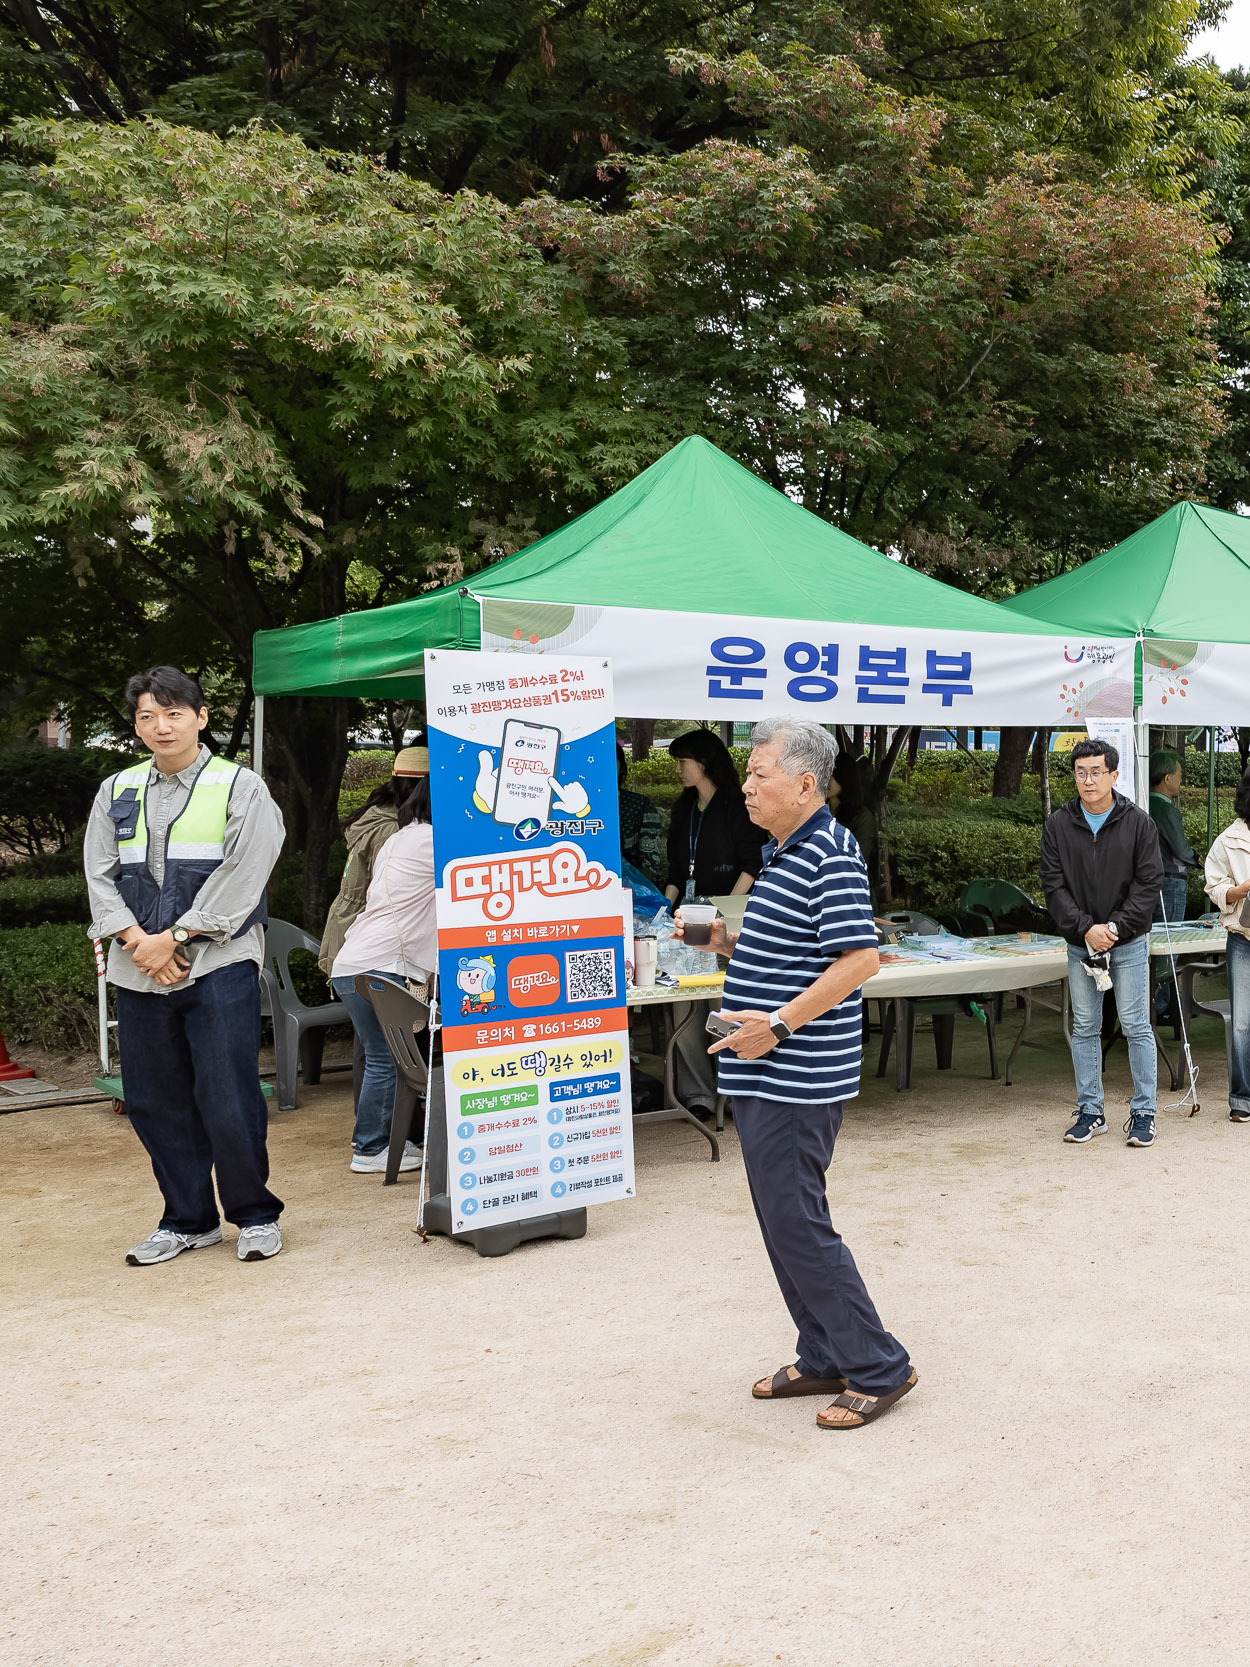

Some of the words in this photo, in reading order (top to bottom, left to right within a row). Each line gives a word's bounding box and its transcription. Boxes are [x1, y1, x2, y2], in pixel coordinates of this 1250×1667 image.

[452, 682, 473, 695] 모든
[476, 679, 505, 693] 가맹점
[508, 673, 558, 690] 중개수수료
[560, 668, 584, 683] 2%!
[705, 636, 974, 707] 운영본부
[437, 703, 468, 717] 이용자
[507, 757, 551, 776] 땡겨요
[546, 819, 604, 836] 광진구
[451, 848, 612, 921] 땡겨요
[485, 930, 496, 943] 앱
[501, 928, 523, 941] 설치
[527, 925, 570, 940] 바로가기
[511, 971, 559, 994] 땡겨요
[475, 1026, 515, 1045] 문의처
[538, 1017, 602, 1035] 1661-5489
[462, 1067, 484, 1082] 야,
[581, 1049, 613, 1069] 있어!
[553, 1083, 582, 1097] 고객님!
[584, 1080, 617, 1094] 땡겨요~
[465, 1096, 498, 1111] 사장님!
[500, 1091, 536, 1106] 땡겨요~
[565, 1105, 579, 1115] 상시
[606, 1099, 620, 1109] 할인
[462, 1126, 468, 1136] 1
[477, 1119, 520, 1134] 중개수수료
[522, 1116, 538, 1126] 2%
[553, 1136, 559, 1145] 2
[566, 1131, 591, 1143] 신규가입
[592, 1128, 608, 1138] 5천원
[609, 1125, 621, 1135] 할인
[463, 1151, 471, 1161] 2
[488, 1143, 523, 1156] 당일정산
[553, 1161, 561, 1170] 3
[567, 1158, 575, 1168] 첫
[576, 1156, 590, 1165] 주문
[591, 1152, 608, 1163] 5천원
[609, 1149, 622, 1159] 할인
[464, 1176, 472, 1186] 3
[479, 1171, 514, 1185] 나눔지원금
[515, 1166, 539, 1178] 30만원
[555, 1185, 562, 1194] 4
[569, 1179, 593, 1192] 리뷰작성
[593, 1176, 611, 1187] 포인트
[612, 1174, 624, 1183] 제공
[465, 1202, 474, 1212] 4
[502, 1194, 519, 1205] 관리
[521, 1190, 538, 1201] 혜택
